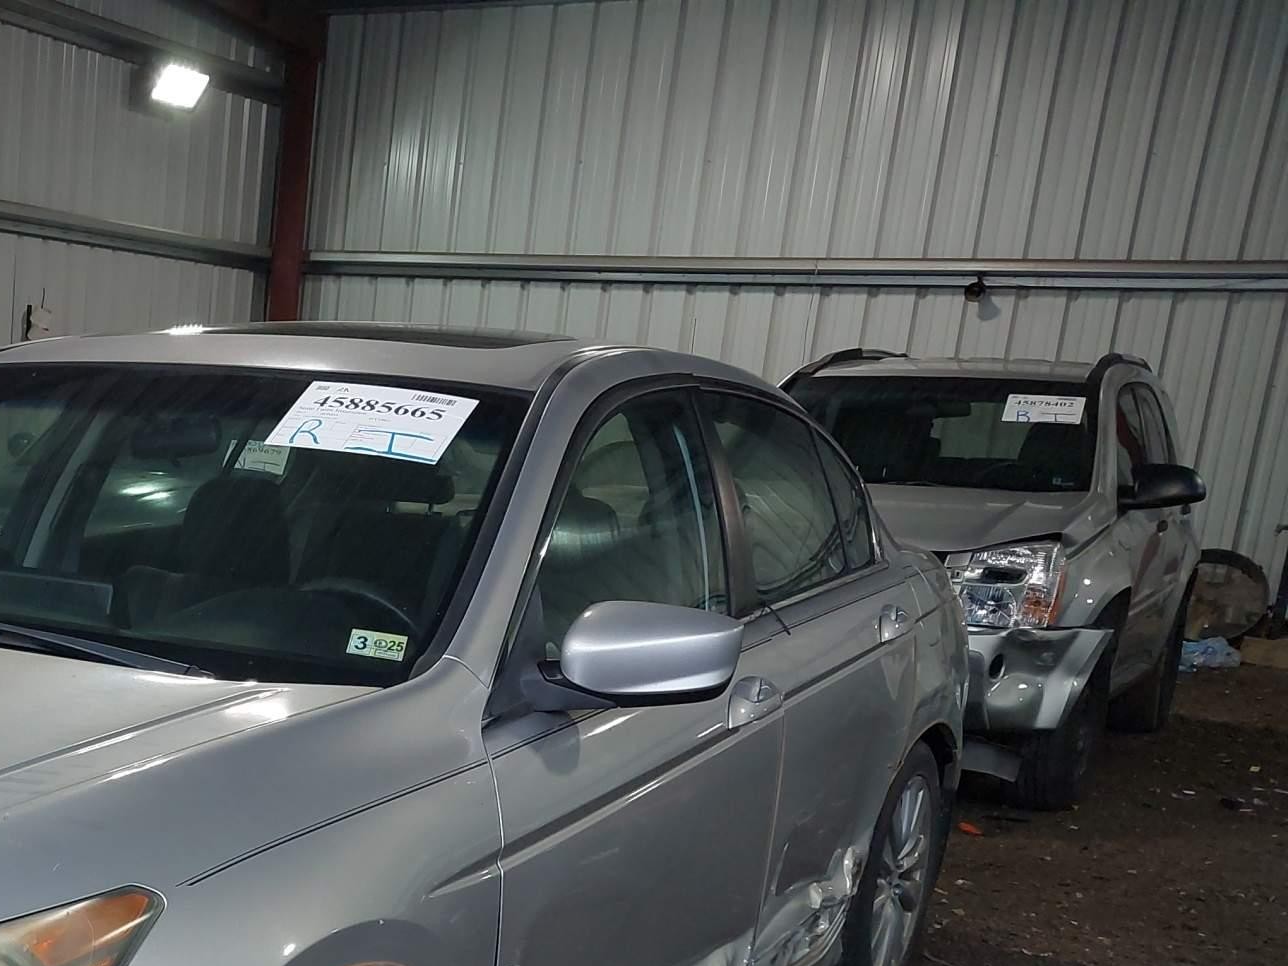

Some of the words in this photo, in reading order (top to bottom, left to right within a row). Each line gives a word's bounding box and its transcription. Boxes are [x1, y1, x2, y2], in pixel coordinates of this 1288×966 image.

[313, 395, 447, 421] 45885665
[289, 418, 322, 444] R
[354, 636, 369, 651] 3
[387, 640, 405, 652] 25
